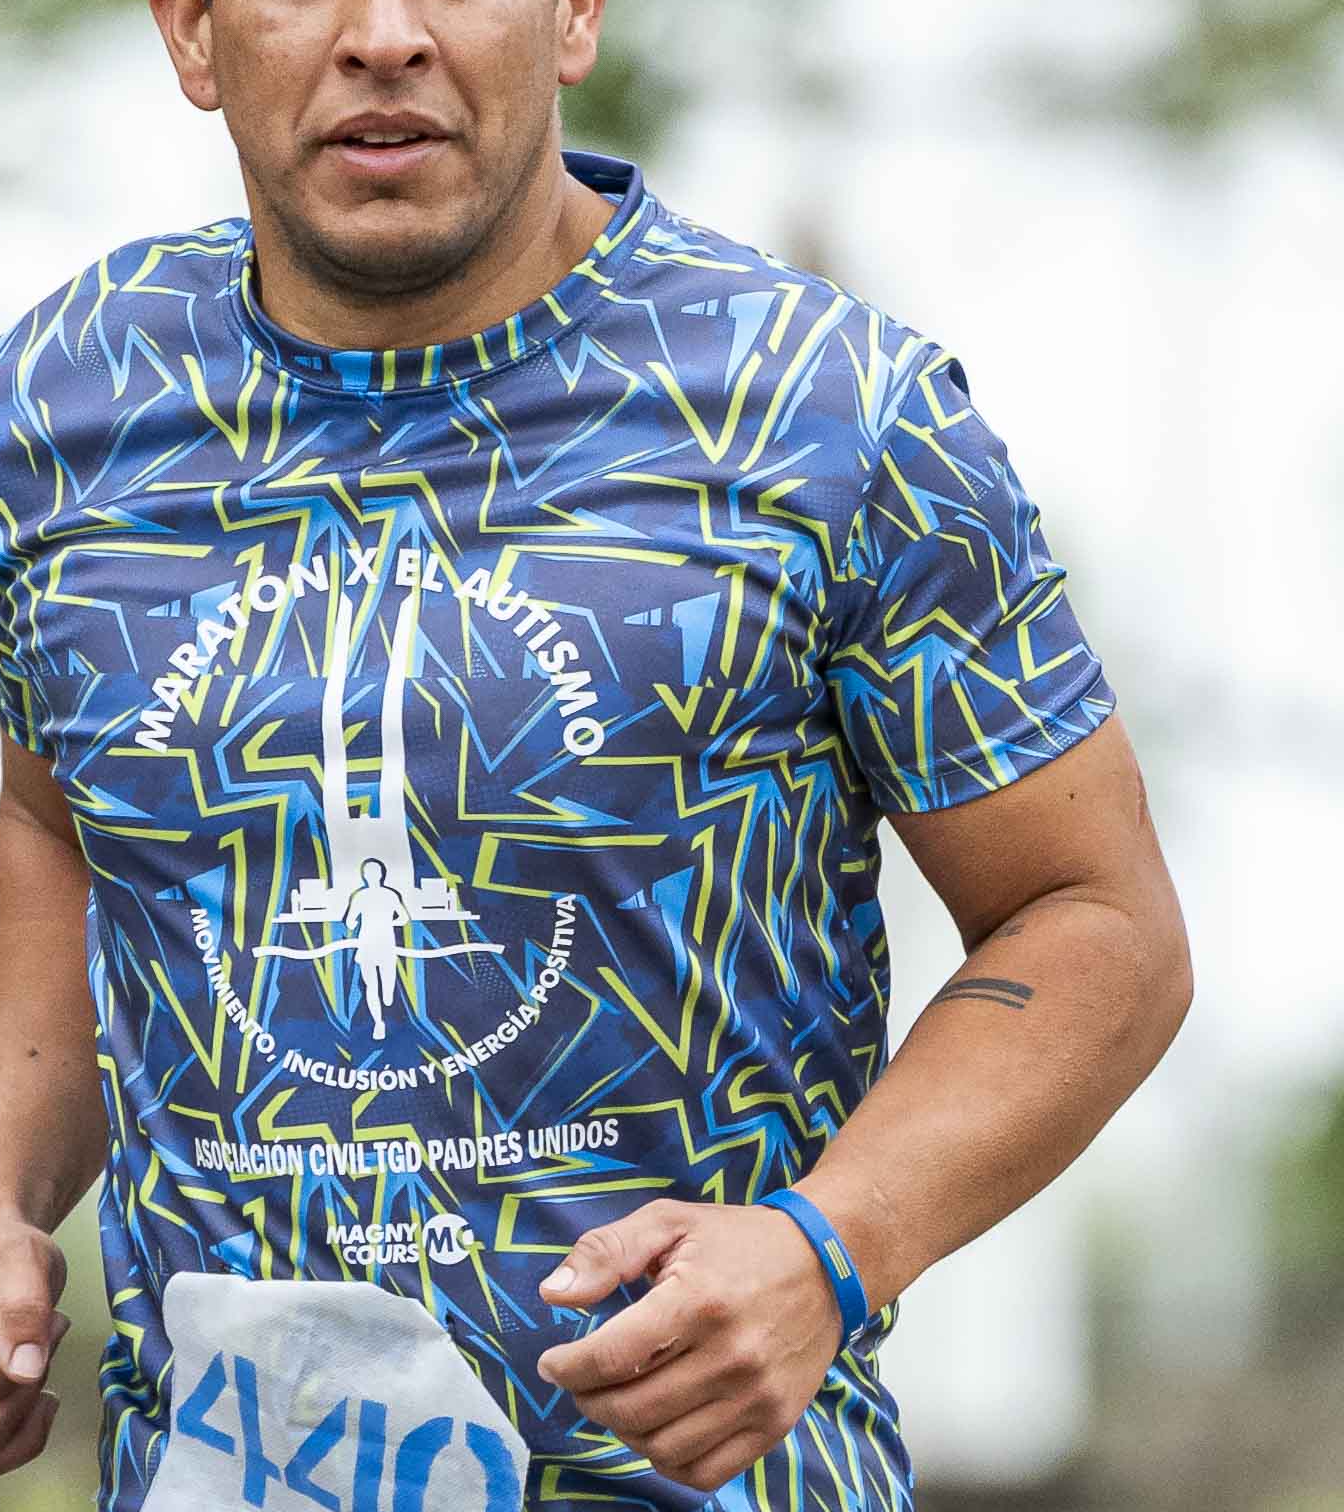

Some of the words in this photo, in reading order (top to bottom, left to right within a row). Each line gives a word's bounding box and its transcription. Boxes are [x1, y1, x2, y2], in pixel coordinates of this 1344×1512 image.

[135, 554, 329, 754] MARATÓN
[345, 547, 380, 586] X
[395, 548, 444, 593] EL
[453, 567, 605, 756] AUTISMO
[190, 908, 277, 1063] MOVIMIENTO,
[282, 1049, 418, 1091] INCLUSIÓN
[419, 1063, 436, 1085] Y
[441, 1003, 541, 1078] ENERGÍA
[529, 893, 577, 1004] POSITIVA
[194, 1135, 305, 1176] ASOCIACIÓN
[309, 1142, 371, 1177] CIVIL
[372, 1141, 422, 1174] TGD
[427, 1130, 524, 1172] PADRES
[528, 1118, 620, 1160] UNIDOS
[326, 1222, 419, 1245] MAGNY
[342, 1243, 420, 1266] COURS
